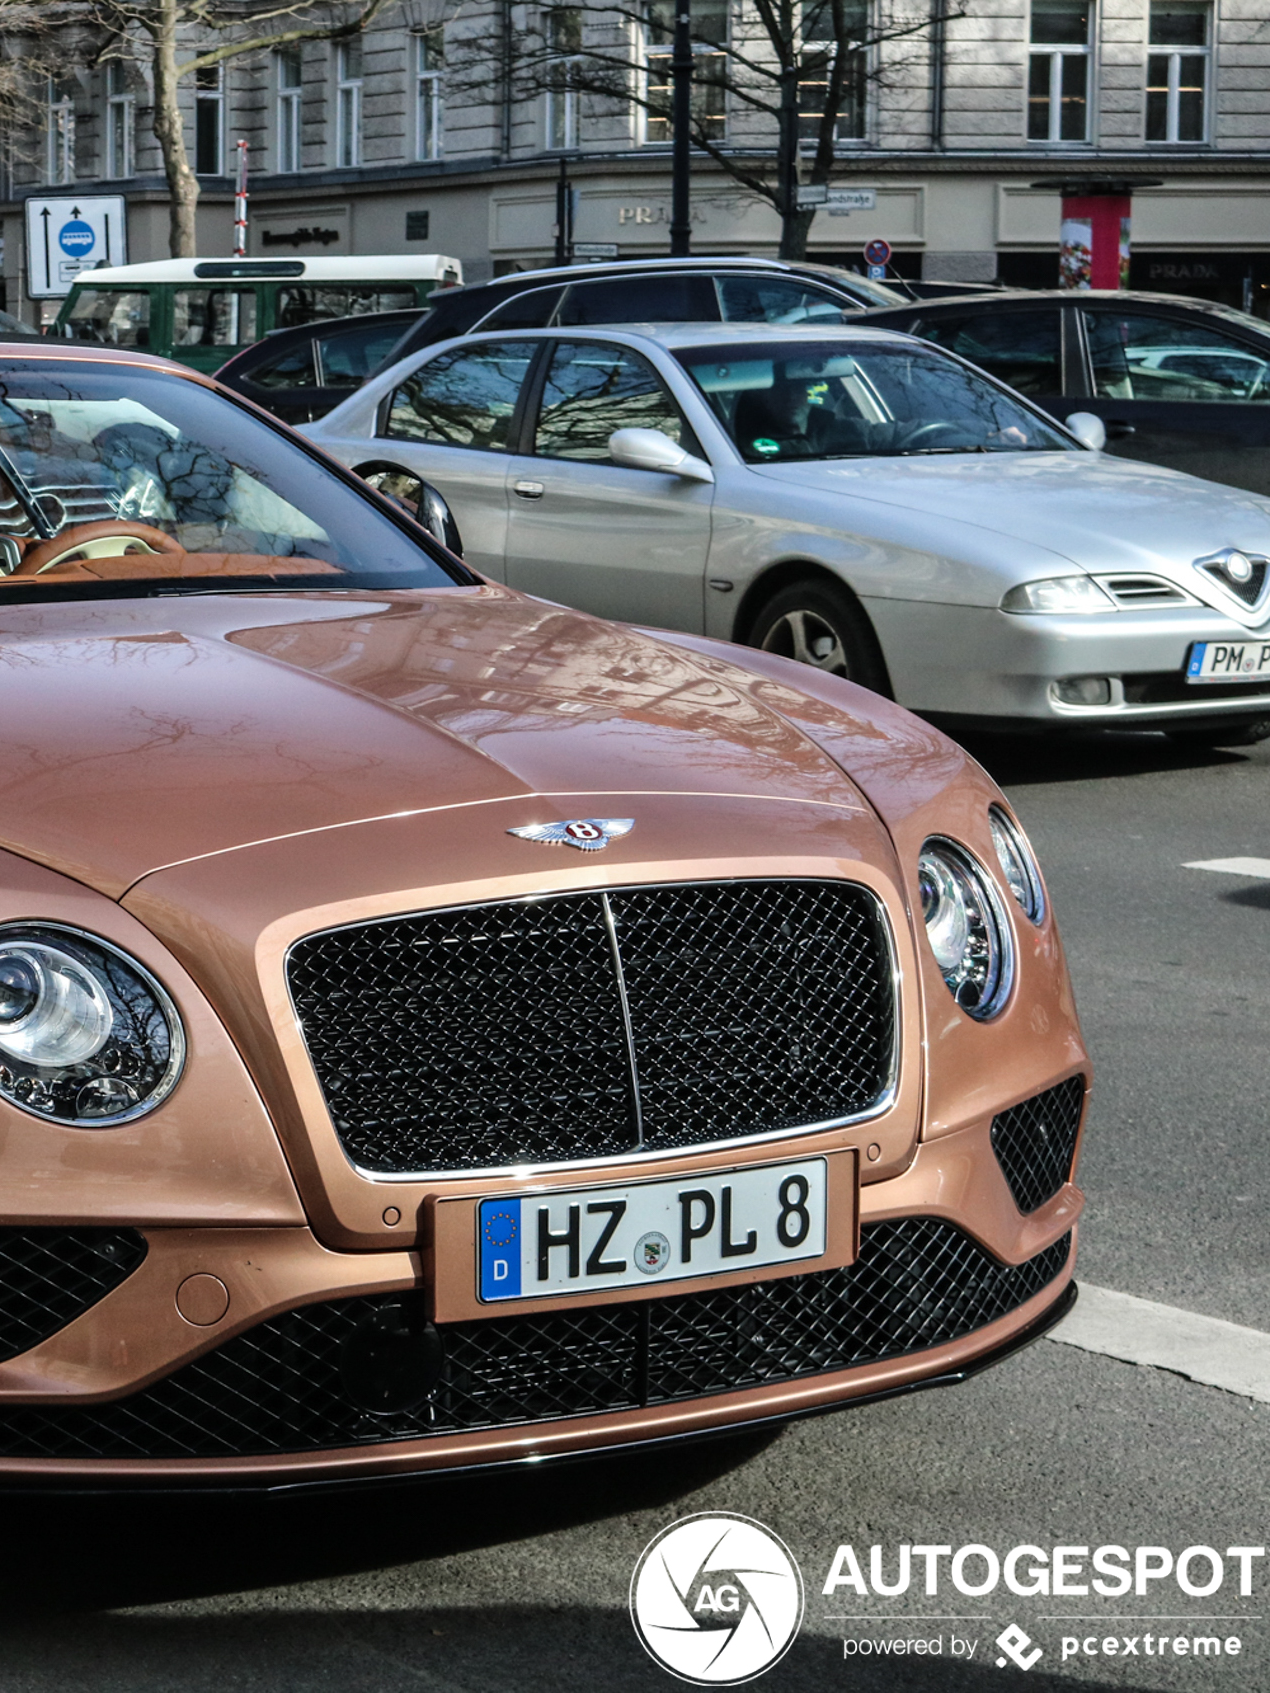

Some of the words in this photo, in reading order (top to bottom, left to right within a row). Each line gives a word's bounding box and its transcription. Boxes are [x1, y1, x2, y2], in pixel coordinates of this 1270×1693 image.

[619, 207, 707, 224] PRAA
[1150, 264, 1219, 279] PRADA
[1211, 646, 1246, 672] PM
[568, 822, 600, 840] B
[493, 1259, 508, 1281] D
[537, 1200, 627, 1281] HZ
[678, 1185, 758, 1263] PL
[776, 1174, 810, 1248] 8
